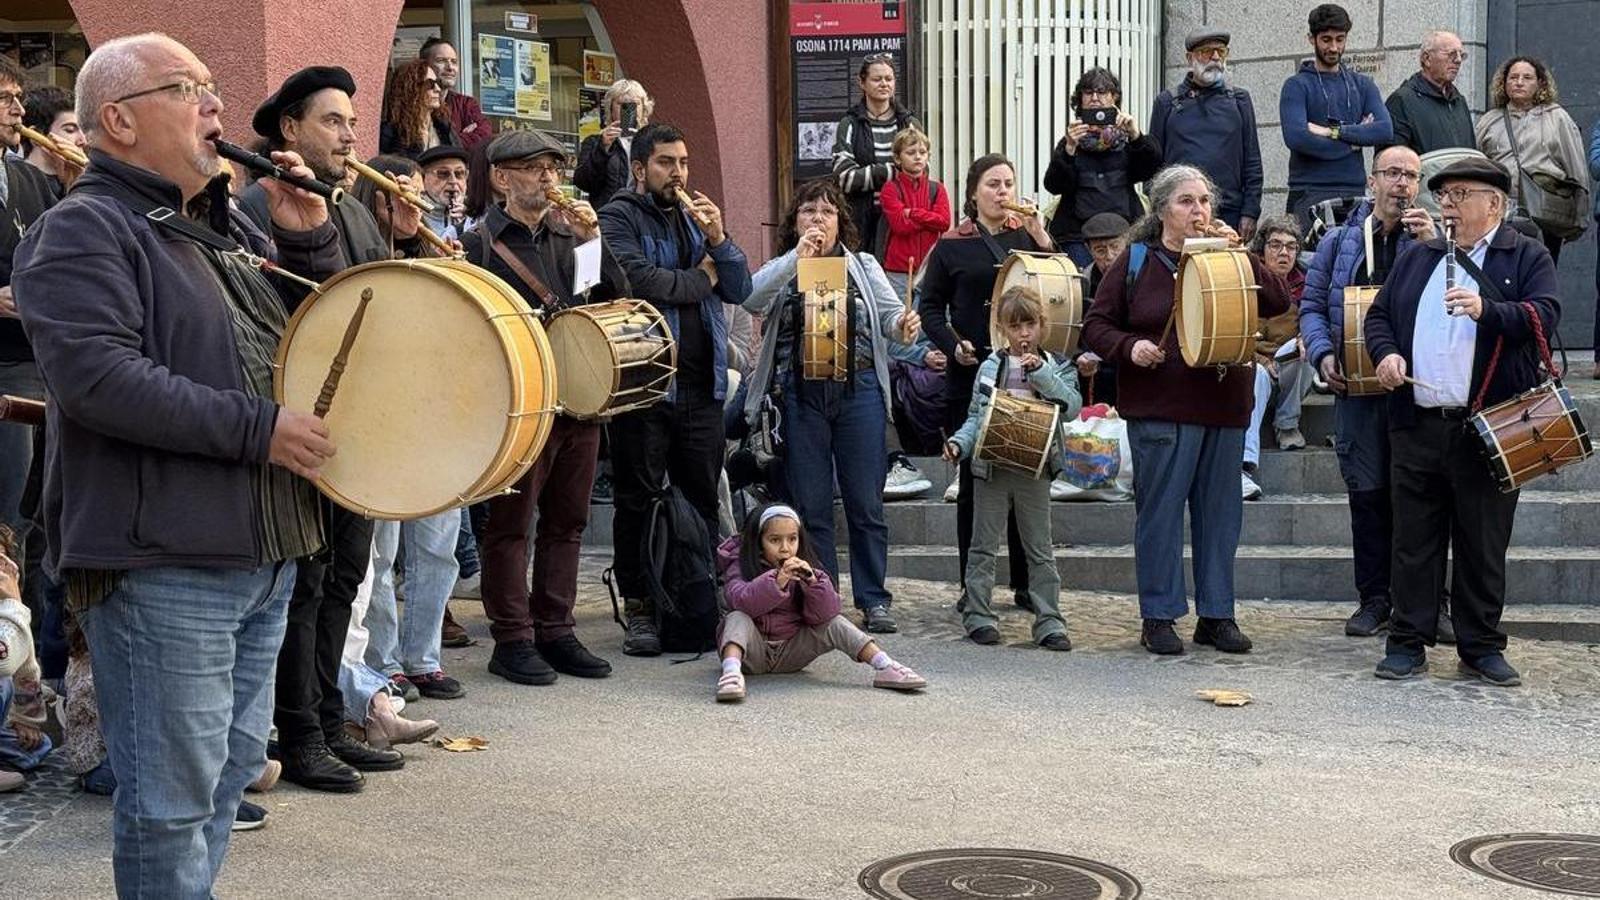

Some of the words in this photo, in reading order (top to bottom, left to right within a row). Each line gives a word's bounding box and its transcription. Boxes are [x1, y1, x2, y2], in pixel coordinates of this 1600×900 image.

[797, 40, 826, 52] OSONA
[829, 39, 850, 51] 1714
[852, 39, 872, 51] PAM
[873, 39, 880, 50] A
[881, 38, 901, 50] PAM
